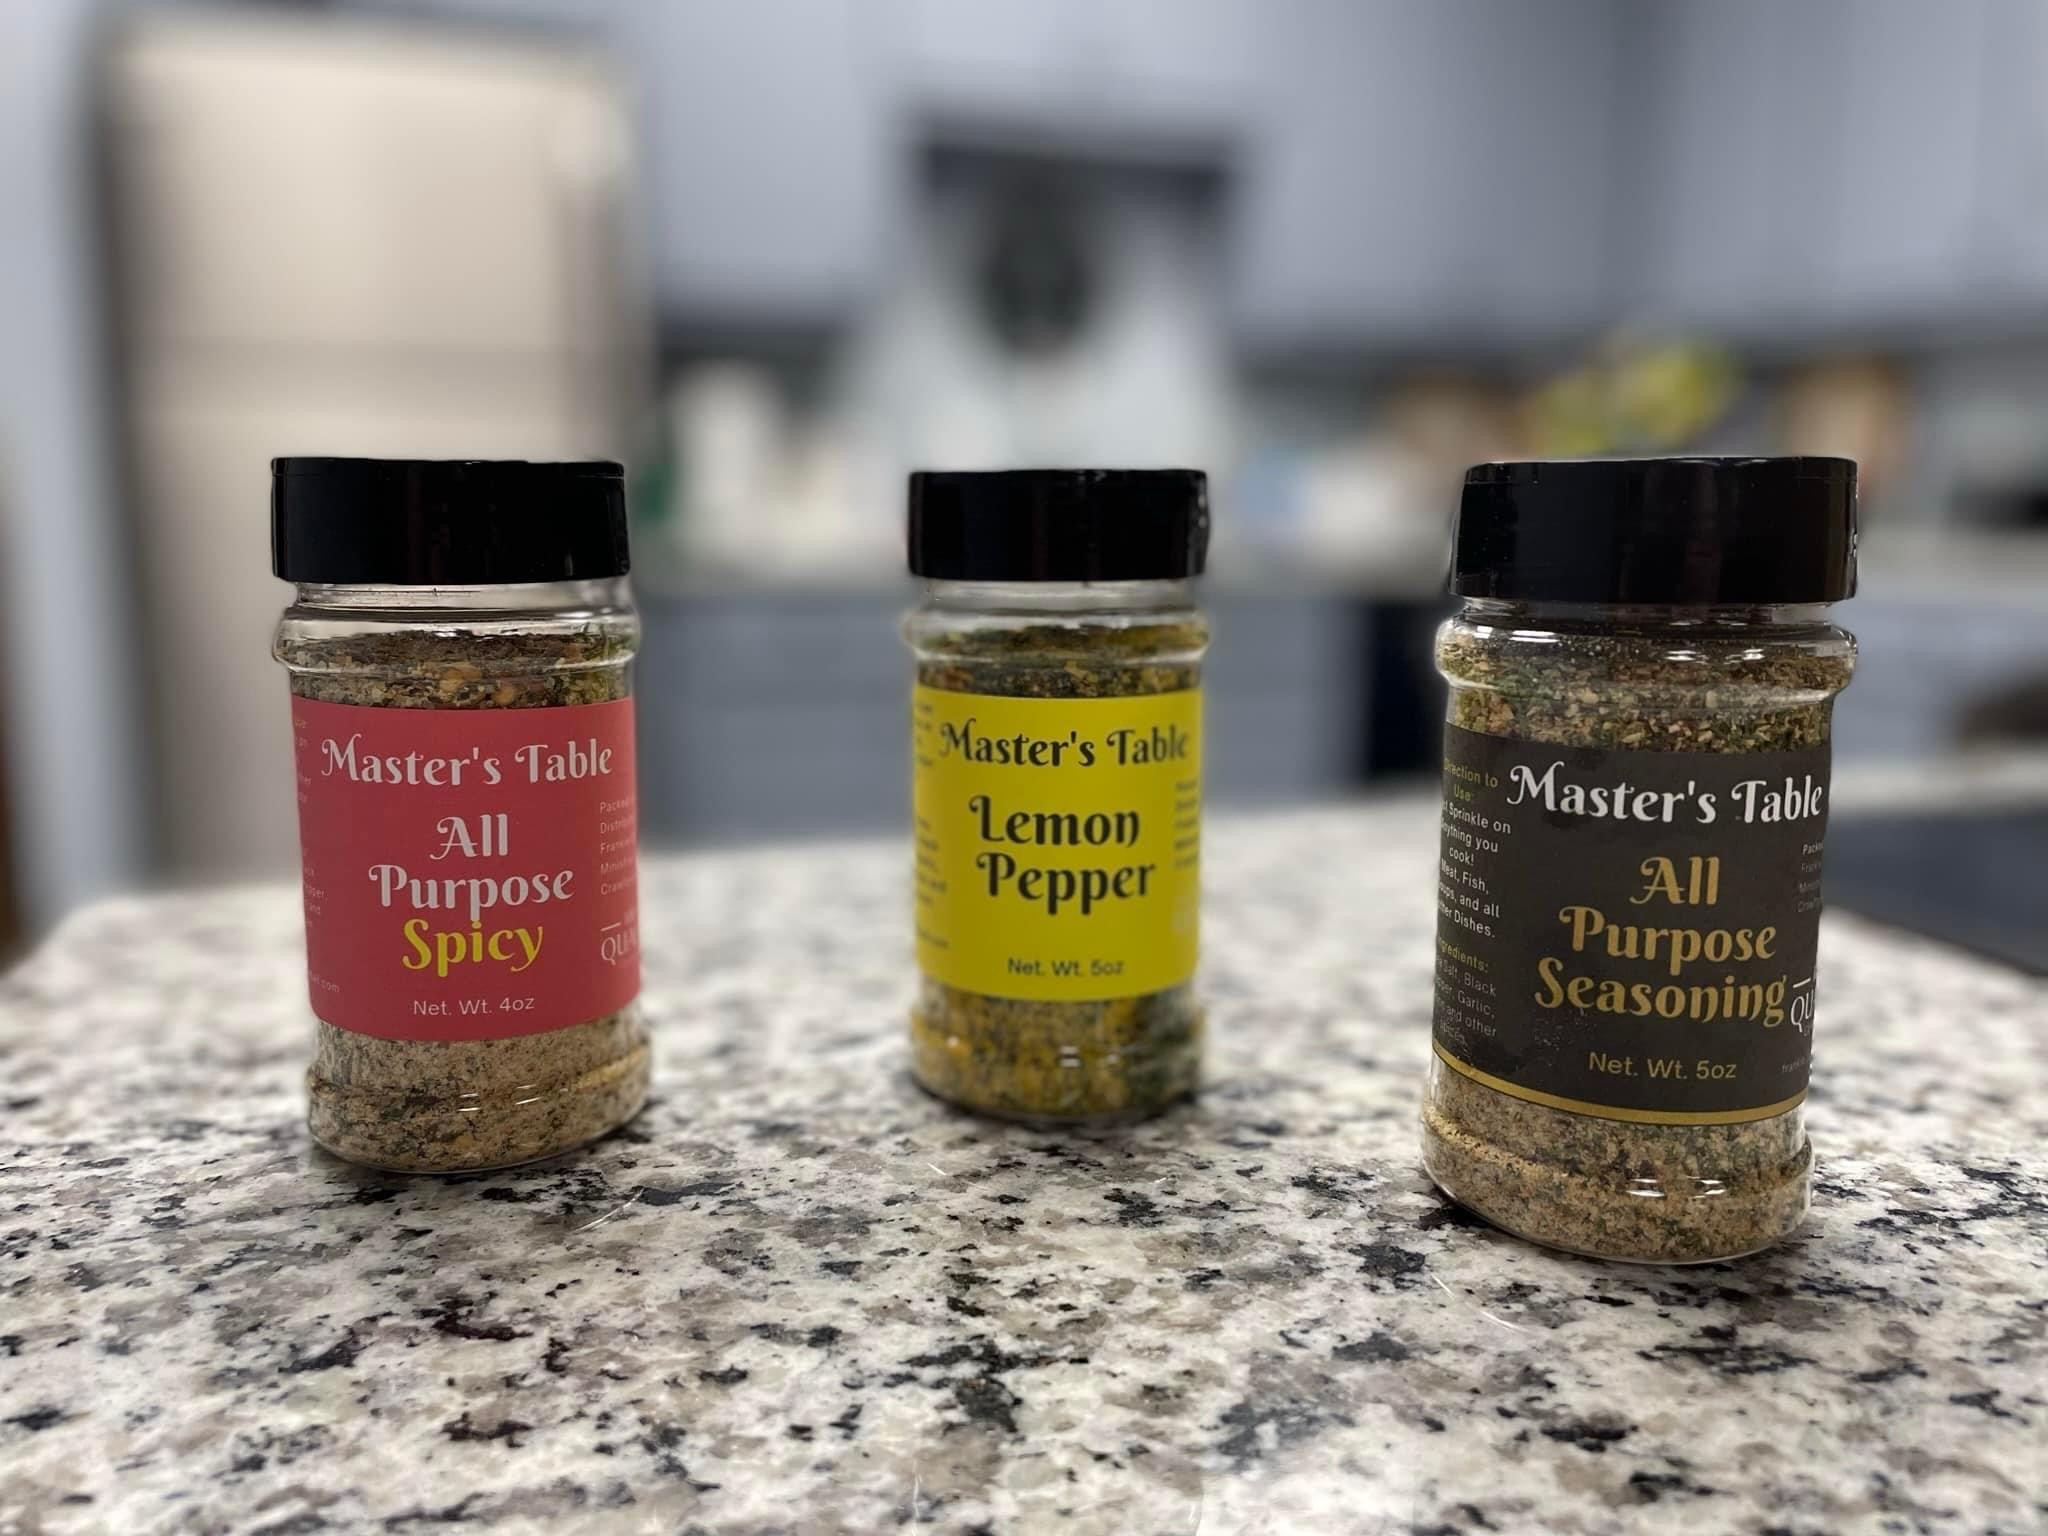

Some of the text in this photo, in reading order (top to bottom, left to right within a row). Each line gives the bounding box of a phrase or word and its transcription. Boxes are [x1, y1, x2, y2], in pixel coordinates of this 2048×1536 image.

[939, 718, 1187, 766] Master's Table
[321, 733, 612, 786] Master's Table
[1485, 772, 1498, 788] to
[1506, 761, 1822, 823] Master's Table
[969, 795, 1140, 848] Lemon
[1449, 801, 1488, 828] Sprinkle
[1493, 820, 1511, 834] on
[430, 813, 508, 860] All
[1475, 836, 1498, 853] you
[1449, 847, 1474, 866] cook!
[368, 864, 575, 922] Purpose
[976, 852, 1156, 916] Pepper
[1462, 871, 1489, 895] Fish,
[1630, 856, 1720, 905] All
[1460, 894, 1479, 911] and
[1483, 903, 1499, 918] all
[1454, 909, 1496, 938] Dishes.
[402, 918, 544, 978] Spicy
[1559, 905, 1777, 977] Purpose
[1008, 957, 1124, 977] Net. Wt. 5oz
[1463, 971, 1497, 997] Black
[1534, 957, 1786, 1027] Seasoning
[413, 997, 535, 1016] Net. Wt. 4oz
[1464, 1016, 1497, 1037] other
[1588, 1051, 1737, 1079] Net. Wt. 5oz
